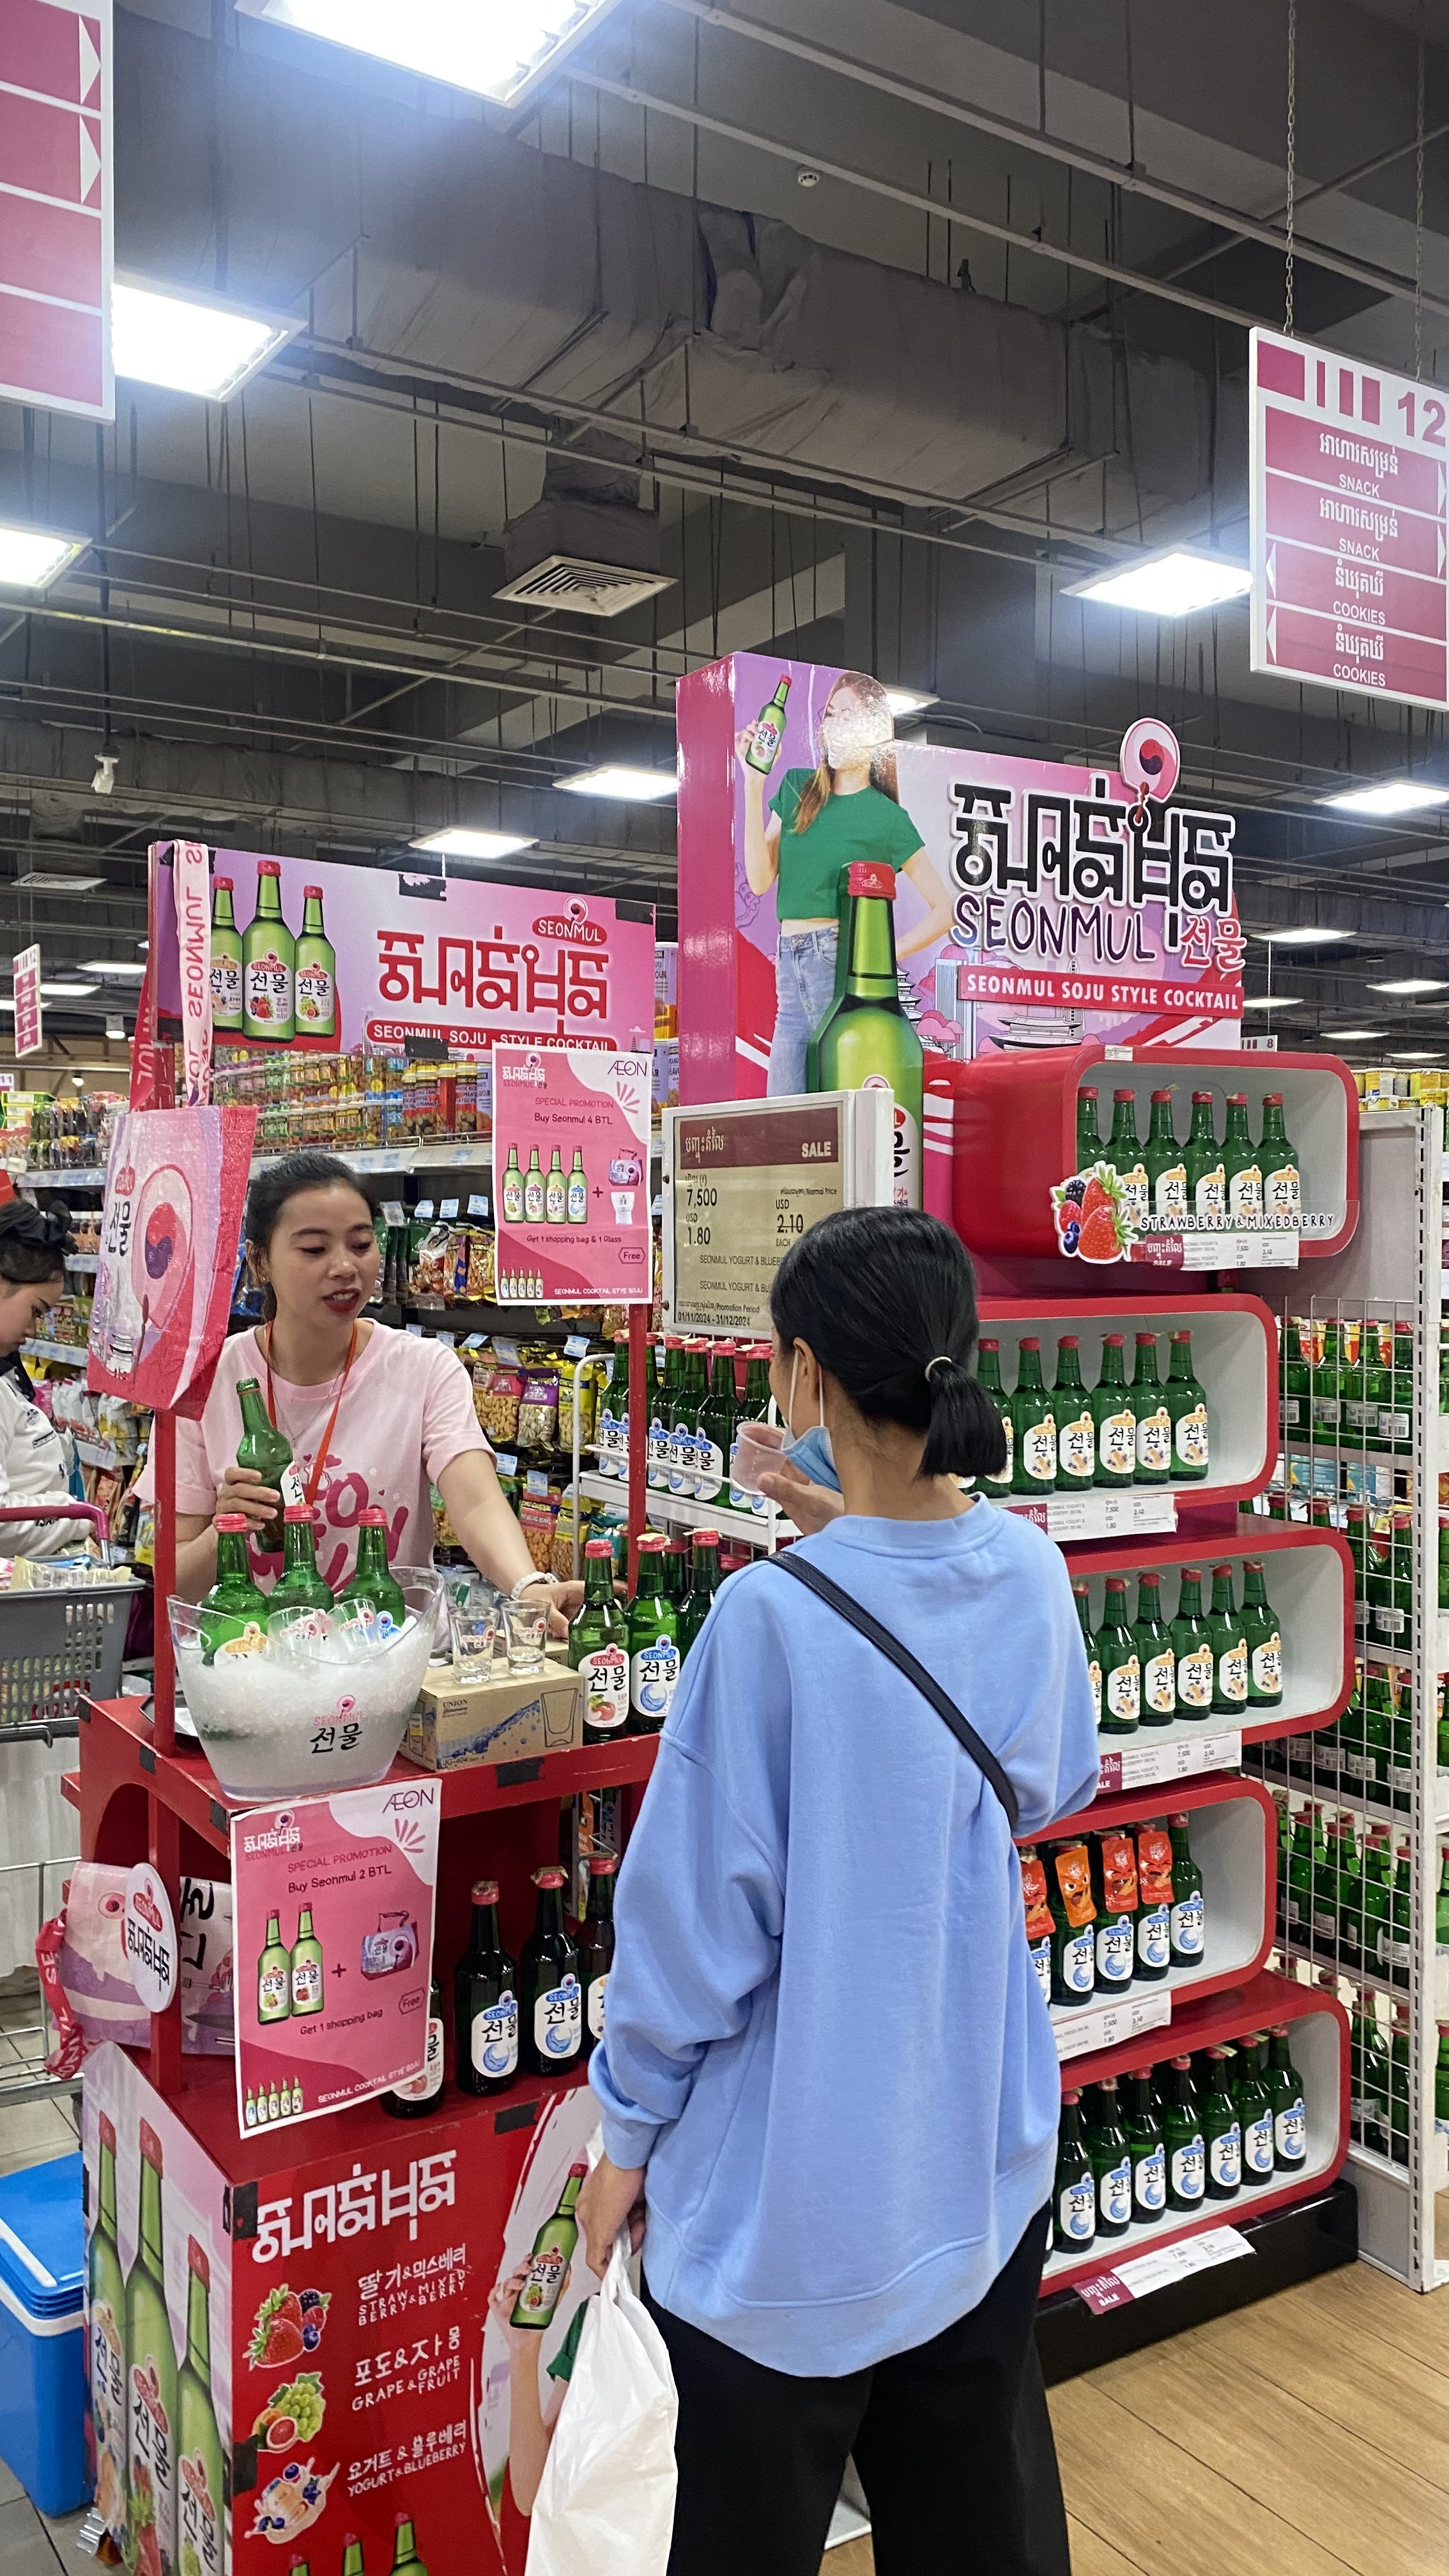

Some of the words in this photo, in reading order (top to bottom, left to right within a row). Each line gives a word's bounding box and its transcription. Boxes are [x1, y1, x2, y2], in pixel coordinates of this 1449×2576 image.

[1397, 391, 1446, 447] 12
[1339, 474, 1380, 498] SNACK
[1339, 538, 1380, 562] SNACK
[1333, 601, 1386, 625] COOKIES
[1333, 663, 1386, 687] COOKIES
[538, 919, 602, 942] SEONMUL
[952, 893, 1156, 963] SEONMUL
[967, 974, 1055, 997] SEONMUL
[1061, 981, 1104, 1001] SOJU
[1111, 985, 1157, 1005] STYLE
[1163, 988, 1238, 1010] COCKTAIL
[449, 1030, 486, 1045] SOJU
[500, 1034, 540, 1046] STYLE
[1268, 1038, 1273, 1048] 8
[535, 1097, 566, 1106] SPECIAL
[569, 1100, 613, 1108] PROMOTION
[535, 1112, 549, 1124] Buy
[552, 1114, 585, 1124] Seonmul
[595, 1116, 613, 1124] BTL
[801, 1142, 831, 1158] SALE
[686, 1188, 717, 1208] 7,500
[776, 1199, 789, 1209] USD
[686, 1213, 698, 1222] USD
[777, 1214, 803, 1233] 2.10
[1140, 1215, 1232, 1230] STRAWBERRY
[1237, 1216, 1243, 1225] &
[1247, 1214, 1334, 1230] MIXEDBERRY
[688, 1227, 710, 1245] 1.80
[700, 1255, 727, 1264] SEONMUL
[729, 1256, 754, 1265] YOGURT
[755, 1257, 759, 1265] &
[760, 1257, 783, 1266] BLUEB
[700, 1280, 726, 1290] SEONMUL
[728, 1282, 753, 1291] YOGURT
[755, 1284, 760, 1292] &
[742, 1305, 760, 1313] Period
[678, 1312, 710, 1323] 01/11/2024
[716, 1315, 750, 1326] 31/12/2024
[443, 1699, 468, 1708] UNION
[1098, 1781, 1110, 1789] ALE
[288, 1857, 330, 1873] SPECIAL
[334, 1844, 392, 1864] PROMOTION
[288, 1882, 308, 1893] Buy
[311, 1871, 356, 1888] Seonmul
[359, 1869, 365, 1879] 2
[369, 1865, 392, 1877] BTL
[402, 1997, 420, 2008] Free
[300, 2025, 317, 2034] Get
[320, 2023, 324, 2031] 1
[326, 2014, 365, 2030] shopping
[367, 2009, 383, 2018] bag
[318, 2087, 353, 2103] SEONMUL
[359, 2288, 408, 2315] STRAW
[418, 2269, 465, 2295] MIXED
[358, 2300, 407, 2326] BERRY
[418, 2280, 465, 2305] BERRY
[418, 2355, 459, 2380] GRAPE
[352, 2379, 404, 2411] GRAPE
[418, 2368, 460, 2394] FRUIT
[397, 2445, 408, 2460] &
